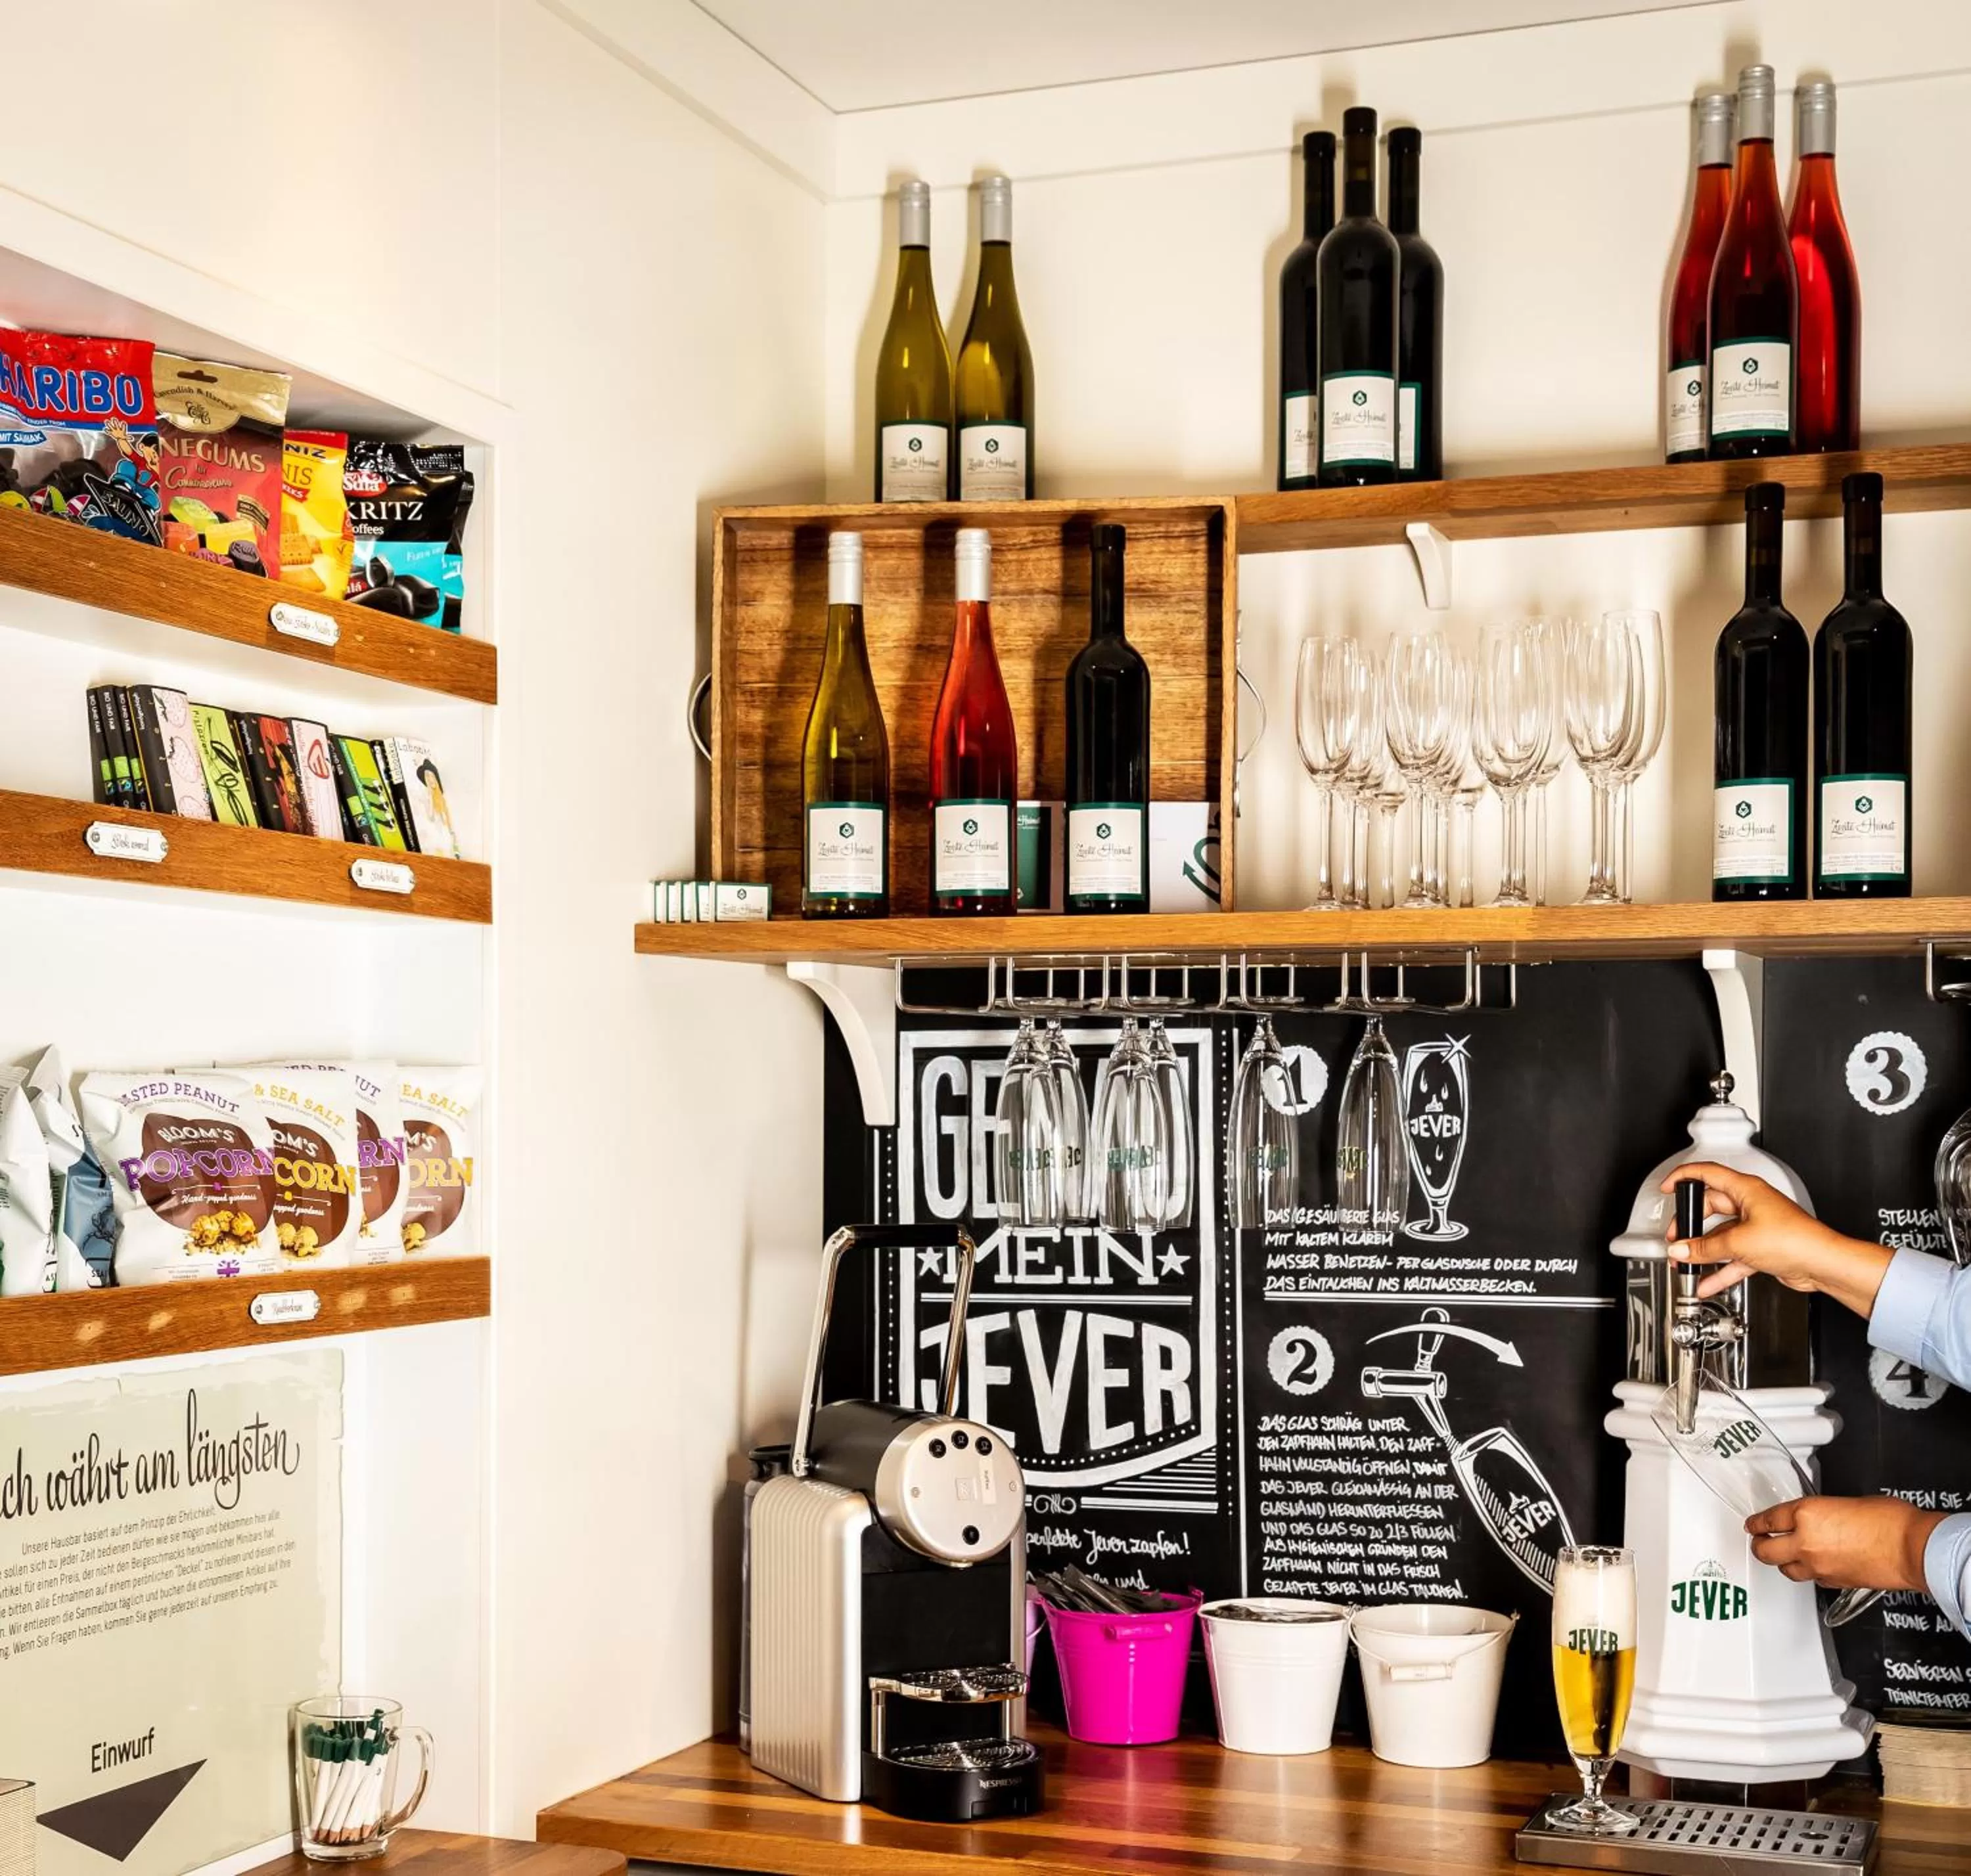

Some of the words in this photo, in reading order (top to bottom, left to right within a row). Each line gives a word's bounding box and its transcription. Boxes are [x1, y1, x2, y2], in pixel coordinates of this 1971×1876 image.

[285, 443, 327, 459] NIZ
[1277, 1053, 1307, 1107] 1
[1864, 1046, 1911, 1106] 3
[121, 1083, 170, 1107] STED
[174, 1082, 240, 1113] PEANUT
[269, 1084, 298, 1105] SEA
[304, 1095, 346, 1127] SALT
[428, 1092, 468, 1117] SALT
[158, 1126, 235, 1144] BLOOM'S
[920, 1055, 1190, 1220] GEU
[1409, 1113, 1462, 1138] JEVER
[118, 1148, 275, 1192] POPCORN
[273, 1157, 357, 1196] CORN
[1265, 1208, 1290, 1224] DAS
[1878, 1208, 1942, 1228] STELLEN
[1265, 1232, 1294, 1246] MIT
[1296, 1231, 1340, 1247] KALTEM
[1343, 1232, 1394, 1247] KLAREM
[941, 1226, 1159, 1285] MEIN
[1267, 1253, 1320, 1270] WASSER
[1493, 1258, 1531, 1272] ODER
[1534, 1259, 1577, 1274] DURCH
[1263, 1276, 1296, 1291] DAS
[1299, 1273, 1374, 1291] EINTAUCHEN
[1377, 1276, 1401, 1291] INS
[1403, 1276, 1537, 1293] KALTWASSERBECKEN.
[1285, 1338, 1318, 1387] 2
[920, 1308, 1193, 1454] JEVER
[1885, 1357, 1930, 1399] 4
[1257, 1414, 1287, 1433] DAS
[1288, 1415, 1319, 1431] GLAS
[1321, 1412, 1363, 1432] SCHRÄG
[1368, 1417, 1411, 1433] UNTER
[0, 1446, 38, 1520] ch
[47, 1433, 129, 1511] währt
[135, 1450, 179, 1494] am
[187, 1388, 300, 1510] längsten
[1257, 1436, 1280, 1452] DEN
[1280, 1434, 1336, 1452] ZAPFHAHN
[1379, 1436, 1405, 1453] DEN
[1407, 1437, 1441, 1452] ZAPF-
[1713, 1419, 1763, 1460] JEVER
[1259, 1455, 1292, 1473] HAHN
[1260, 1479, 1285, 1495] DAS
[1286, 1481, 1328, 1496] JEVER
[1414, 1483, 1432, 1500] AN
[1434, 1484, 1459, 1501] DER
[1940, 1492, 1963, 1509] SIE
[1260, 1499, 1326, 1519] GLASWAND
[1502, 1500, 1556, 1542] JEVER
[22, 1540, 49, 1556] Unsere
[51, 1532, 81, 1550] Hausbar
[83, 1525, 109, 1544] basiert
[110, 1523, 123, 1537] auf
[124, 1520, 139, 1535] dem
[166, 1513, 177, 1527] der
[1261, 1521, 1288, 1537] UND
[1290, 1521, 1315, 1536] DAS
[1316, 1521, 1348, 1536] GLAS
[1349, 1523, 1367, 1537] SO
[1384, 1523, 1409, 1541] 2/3
[1263, 1535, 1286, 1553] AUS
[1287, 1538, 1365, 1557] HYGIENISCHEN
[1367, 1540, 1418, 1560] GRÜNDEN
[1421, 1544, 1449, 1560] DEN
[4, 1564, 28, 1580] sollen
[31, 1559, 47, 1574] sich
[48, 1558, 58, 1570] zu
[60, 1553, 79, 1570] jeder
[81, 1547, 96, 1563] Zeit
[24, 1578, 35, 1594] für
[37, 1576, 59, 1591] einen
[82, 1567, 95, 1580] der
[117, 1559, 130, 1573] den
[1262, 1556, 1323, 1574] ZAPFHAHN
[1326, 1557, 1360, 1576] NICHT
[1362, 1560, 1376, 1576] IN
[1377, 1562, 1401, 1576] DAS
[1403, 1561, 1441, 1578] FRISCH
[35, 1596, 50, 1611] alle
[52, 1586, 94, 1607] Entnahmen
[95, 1582, 108, 1596] auf
[1263, 1578, 1321, 1596] GEZAPFTE
[1321, 1581, 1361, 1596] JEVER
[1358, 1580, 1377, 1596] IM
[1378, 1580, 1409, 1596] GLAS
[1670, 1579, 1748, 1620] JEVER
[9, 1621, 22, 1636] Wir
[24, 1614, 61, 1632] entleeren
[76, 1600, 118, 1619] Sammelbox
[12, 1638, 35, 1655] Wenn
[36, 1634, 49, 1649] Sie
[51, 1628, 77, 1645] Fragen
[104, 1614, 135, 1630] kommen
[135, 1609, 147, 1624] Sie
[1882, 1611, 1930, 1632] KRONE
[1568, 1628, 1619, 1656] JEVER
[91, 1726, 155, 1773] Einwurf
